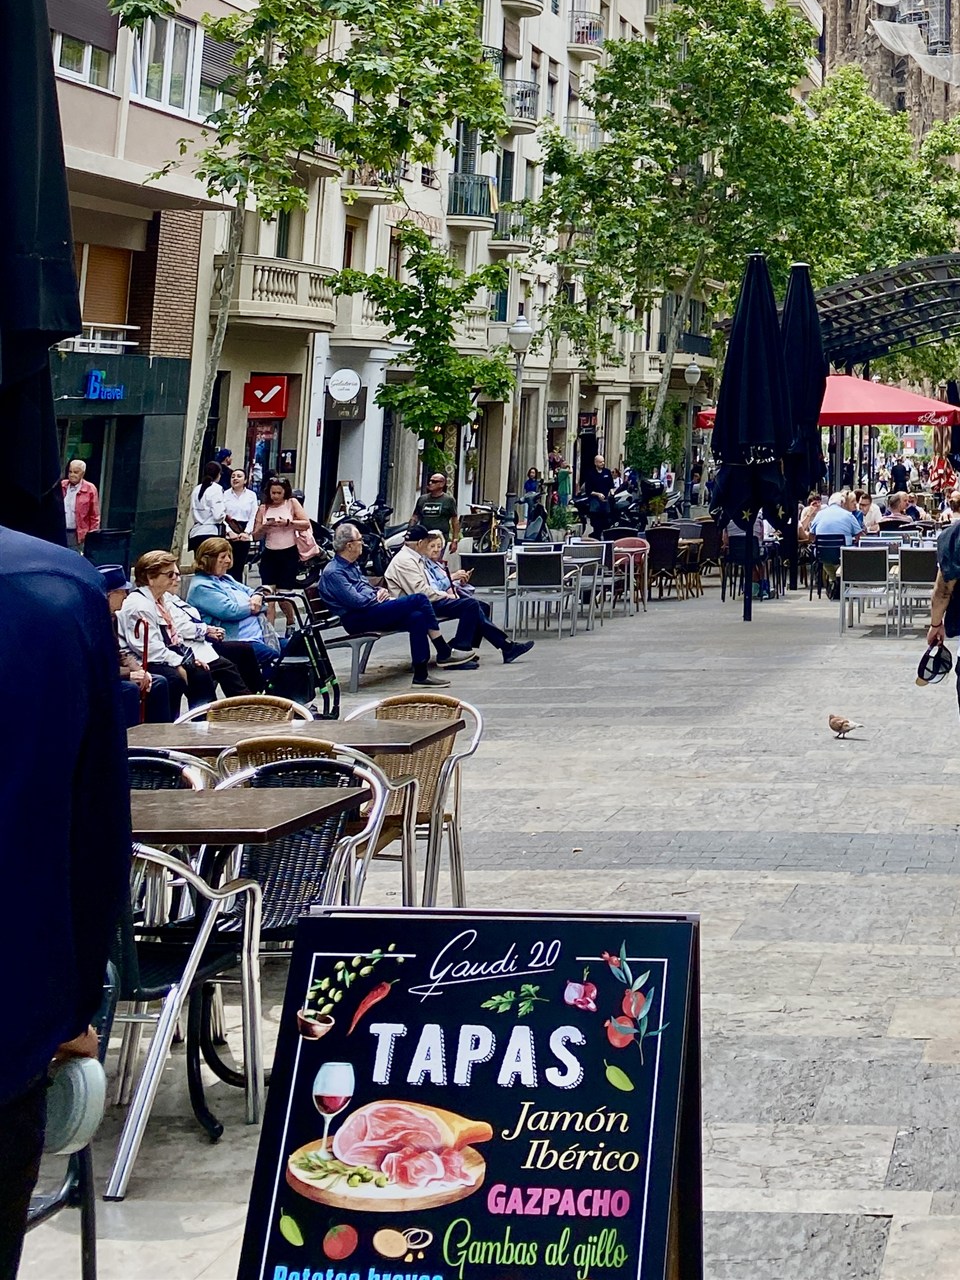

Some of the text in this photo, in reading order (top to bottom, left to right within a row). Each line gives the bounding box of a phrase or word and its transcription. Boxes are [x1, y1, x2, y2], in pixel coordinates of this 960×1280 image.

[416, 929, 562, 1003] Gaudi 20
[369, 1022, 587, 1090] TAPAS
[501, 1101, 630, 1141] Jamón
[520, 1139, 640, 1172] Ibérico
[487, 1184, 631, 1218] GAZPACHO
[442, 1218, 629, 1280] Gambas al ajillo
